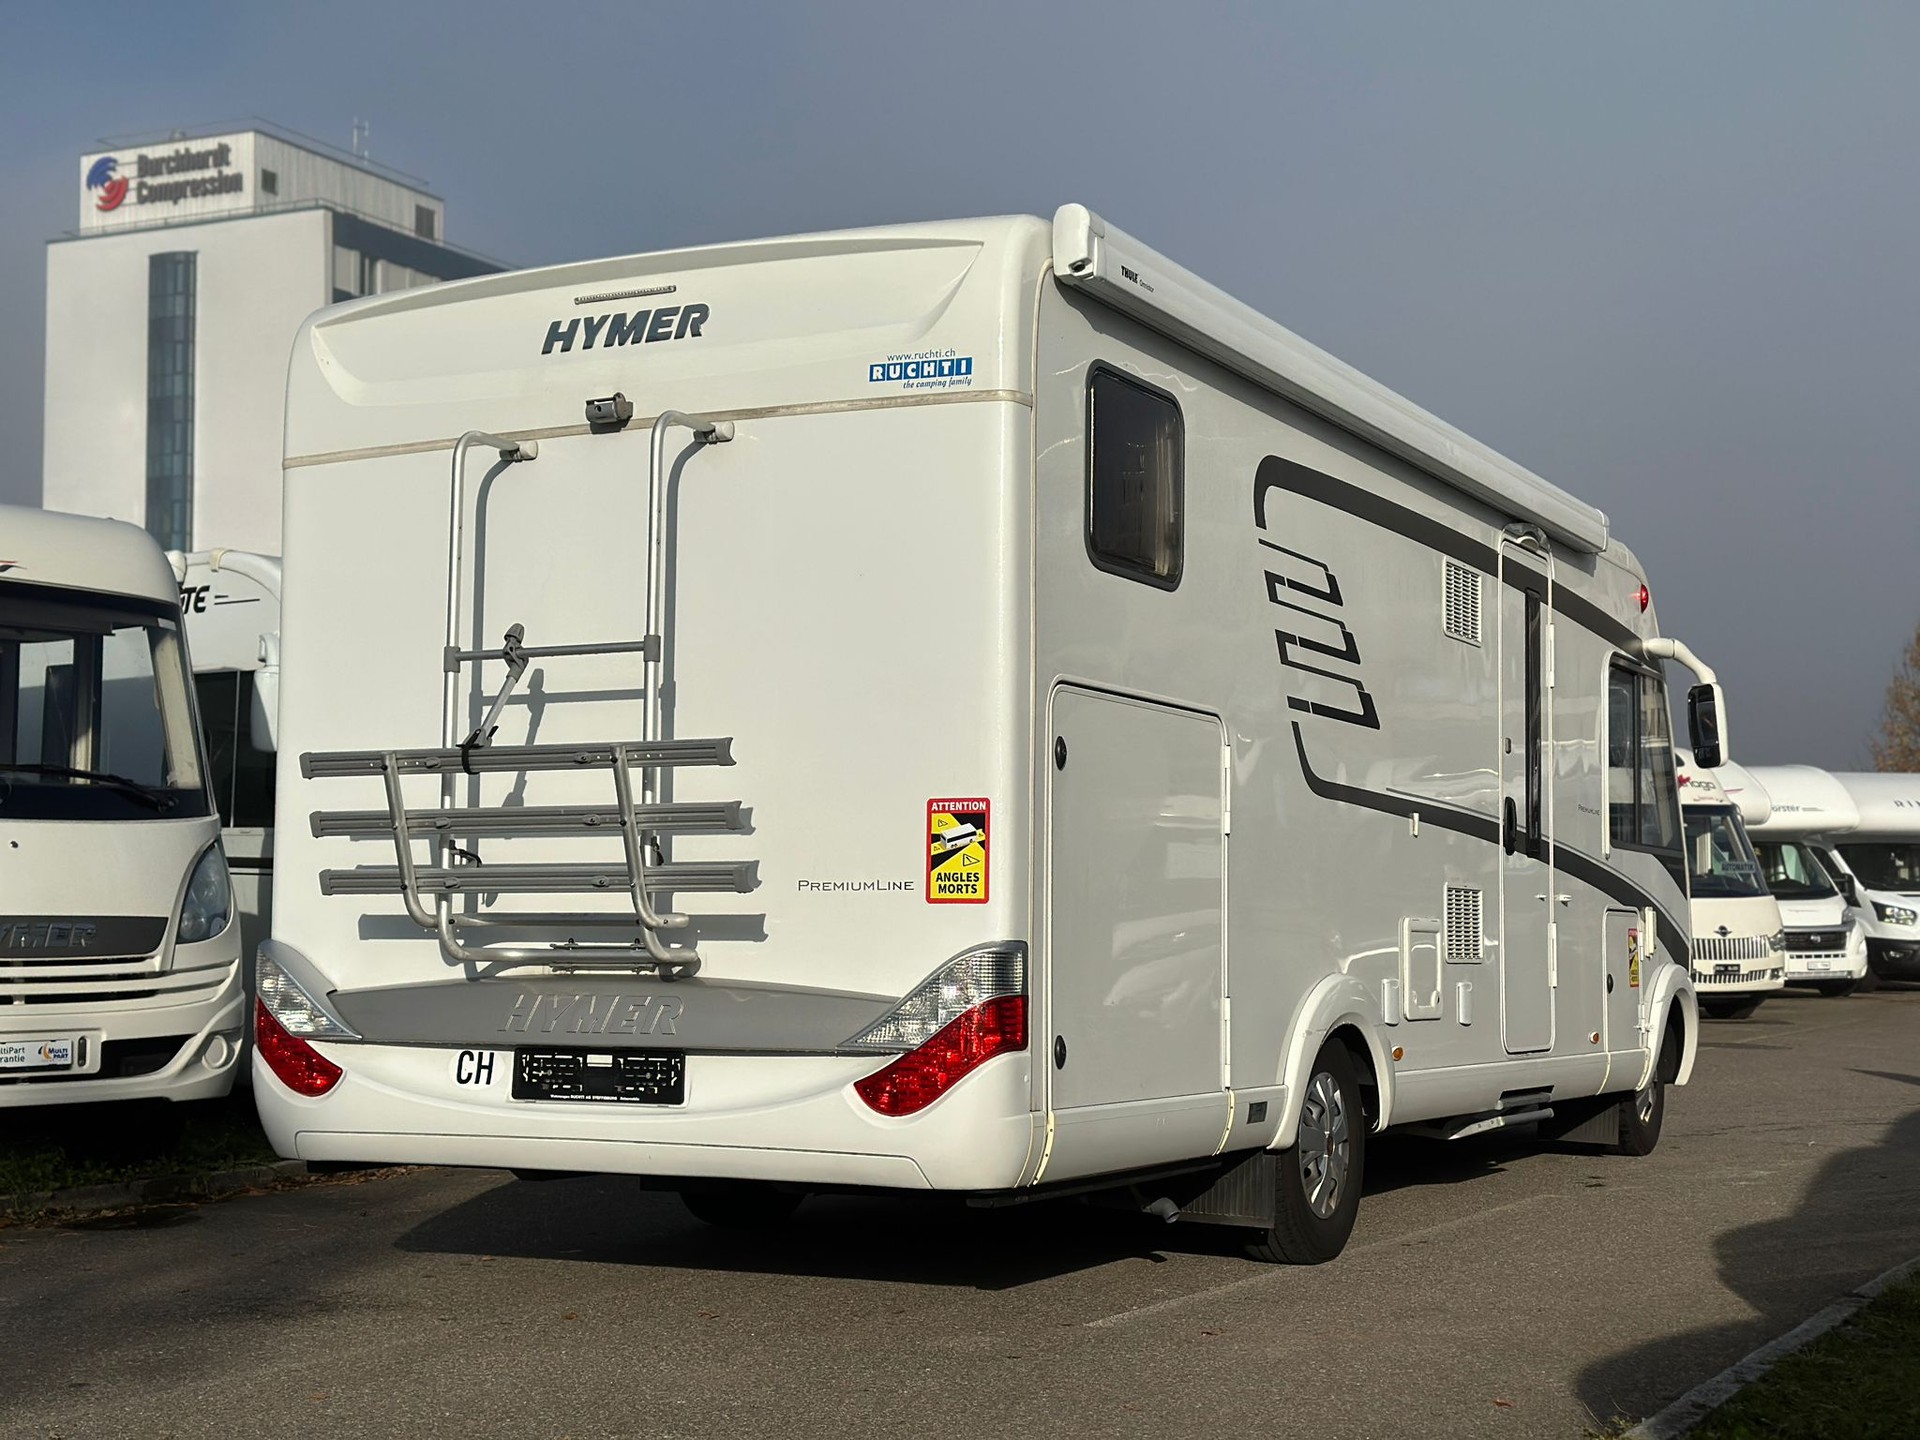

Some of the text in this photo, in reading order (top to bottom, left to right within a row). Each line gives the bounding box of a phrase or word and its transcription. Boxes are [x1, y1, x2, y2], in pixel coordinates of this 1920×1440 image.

[138, 142, 232, 178] Burckhardt
[137, 169, 244, 206] Compression
[541, 303, 710, 355] HYMER
[887, 348, 956, 361] www.ruchti.ch
[871, 359, 968, 380] RUCHTI
[903, 376, 972, 389] the camping family
[180, 585, 211, 615] TE
[931, 801, 986, 811] ATTENTION
[936, 872, 979, 883] ANGLES
[938, 884, 978, 894] MORTS
[497, 994, 685, 1036] HYMER
[0, 1046, 25, 1055] ltiPart
[0, 1055, 25, 1063] rantie
[456, 1050, 495, 1085] CH
